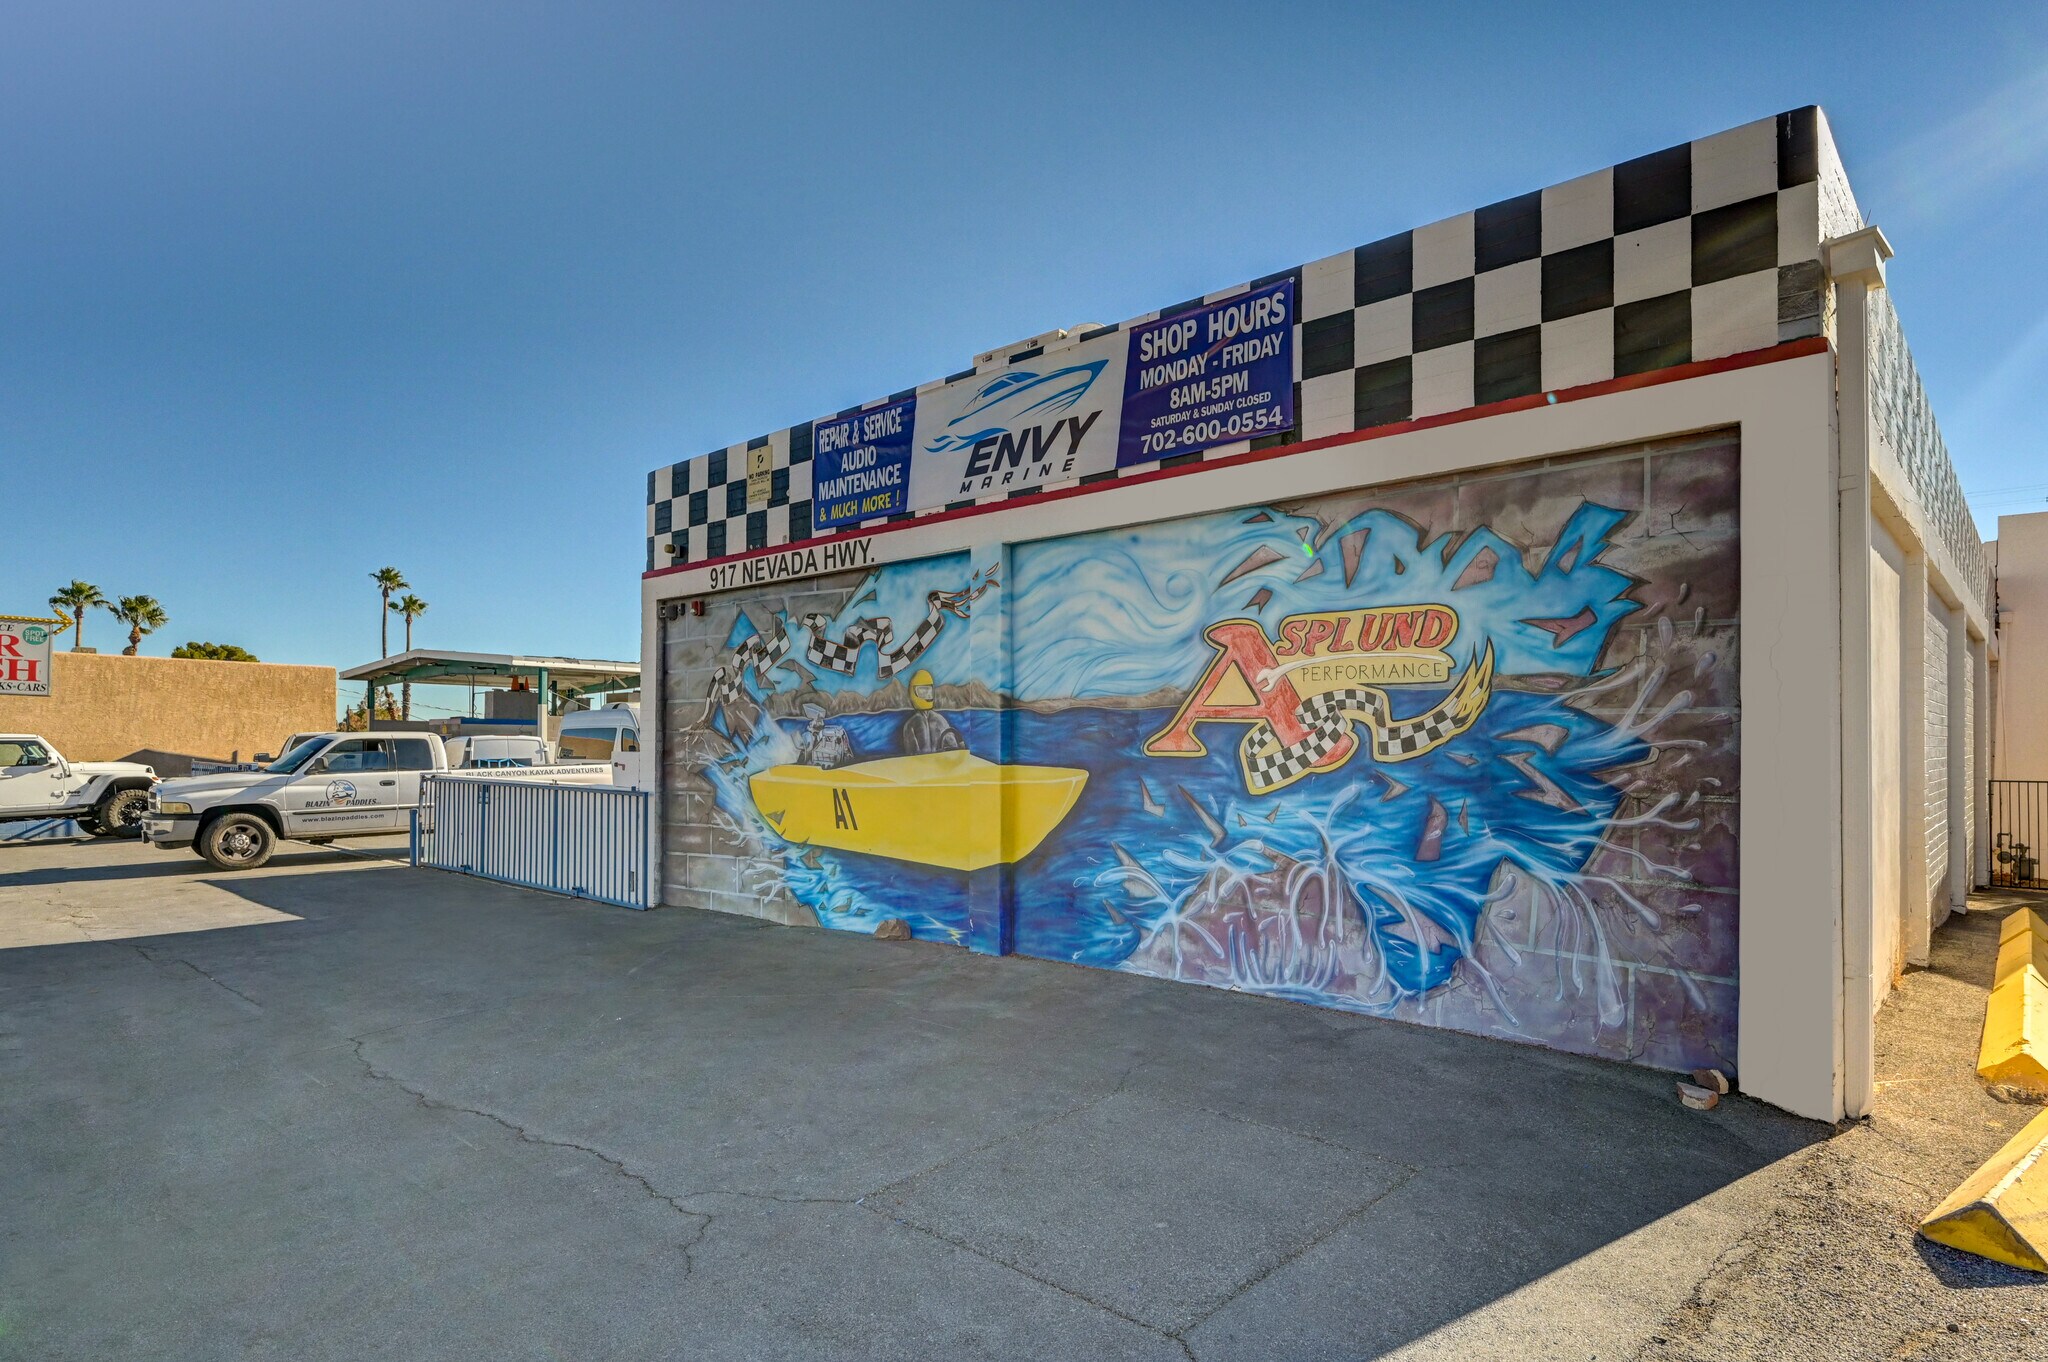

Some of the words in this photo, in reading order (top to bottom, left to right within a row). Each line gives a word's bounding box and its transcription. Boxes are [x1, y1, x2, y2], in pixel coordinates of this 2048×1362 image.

[1139, 319, 1197, 362] SHOP
[1208, 292, 1286, 343] HOURS
[1139, 352, 1209, 390] MONDAY
[1222, 332, 1284, 369] FRIDAY
[1170, 369, 1249, 410] 8AM-5PM
[1140, 405, 1283, 454] 702-600-0554
[1150, 408, 1192, 429] SATURDAY
[1192, 408, 1200, 418] &
[1200, 399, 1235, 417] SUNDAY
[1236, 391, 1272, 409] CLOSED
[819, 423, 850, 454] REPAIR
[852, 420, 860, 445] &
[863, 407, 903, 442] SERVICE
[964, 409, 1103, 479] ENVY
[841, 445, 877, 473] AUDIO
[959, 458, 1075, 494] MARINE
[818, 463, 902, 502] MAINTENANCE
[819, 507, 827, 522] &
[830, 499, 858, 520] MUCH
[862, 492, 892, 514] MORE
[710, 564, 737, 590] 917
[742, 548, 818, 584] NEVADA
[824, 538, 875, 570] HWY.
[1301, 661, 1443, 682] PERFORMANCE
[495, 769, 528, 777] CANYON
[529, 768, 555, 776] KAYAK
[556, 767, 604, 775] ADVENTURES
[301, 813, 385, 823] www.blazinpaddles.com
[345, 798, 377, 806] PADDLES
[832, 788, 859, 831] A1
